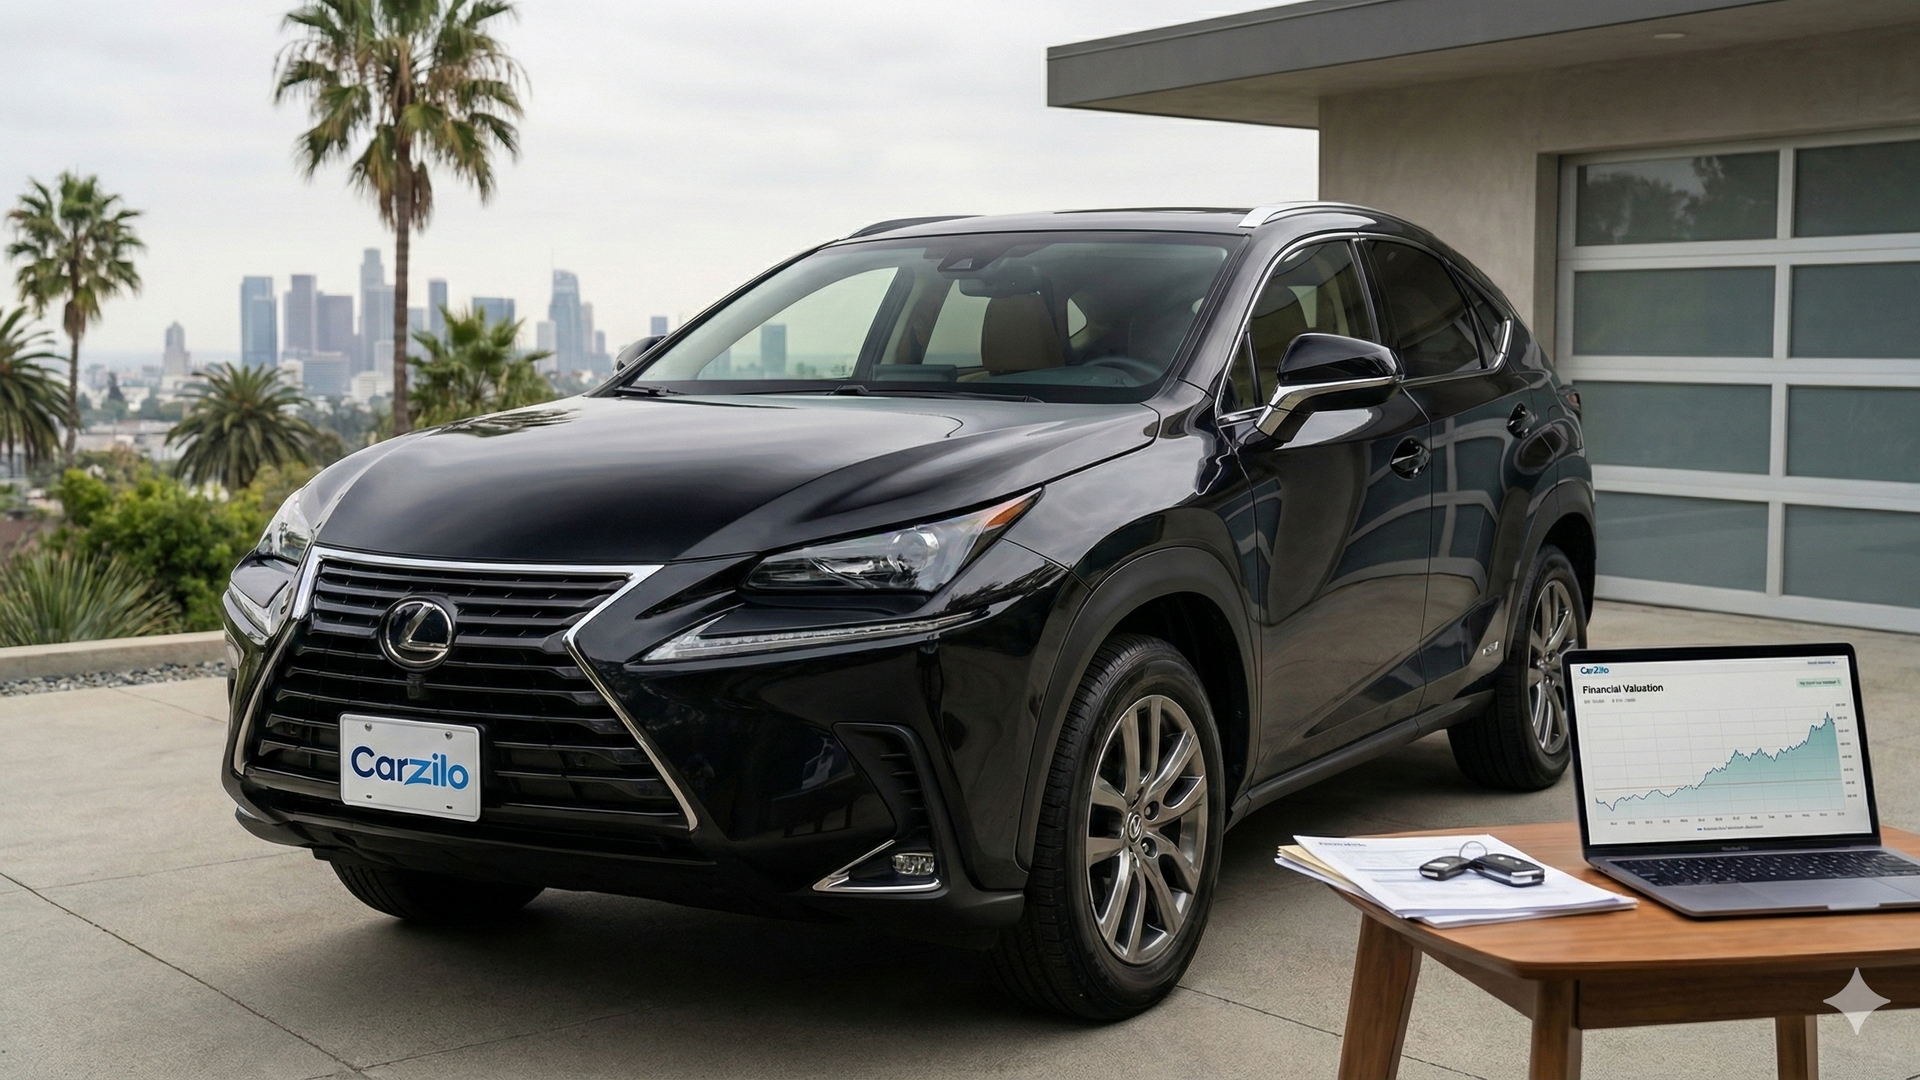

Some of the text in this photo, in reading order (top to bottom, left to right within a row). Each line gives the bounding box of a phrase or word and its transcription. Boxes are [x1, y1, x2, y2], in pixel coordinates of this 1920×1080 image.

[1582, 683, 1664, 695] Financial Valuation
[351, 745, 469, 790] Carzilo
